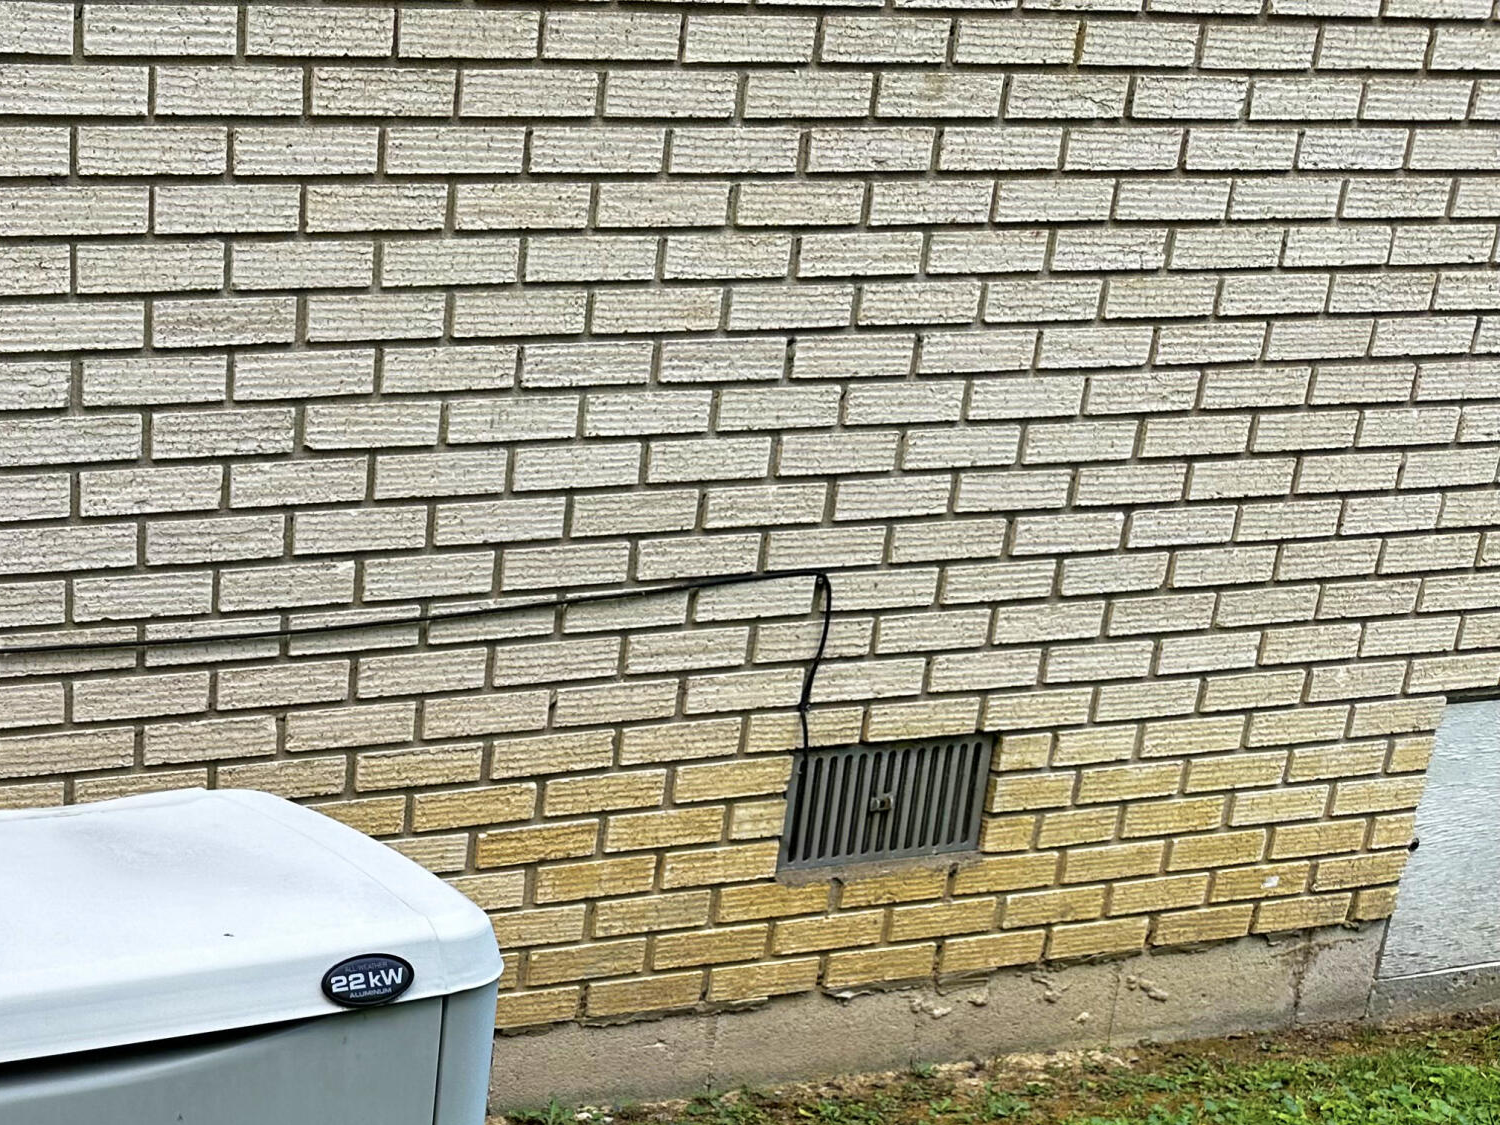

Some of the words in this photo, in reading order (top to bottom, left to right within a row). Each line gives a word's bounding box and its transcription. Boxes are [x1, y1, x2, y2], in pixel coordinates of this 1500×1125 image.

[330, 973, 367, 993] 22
[369, 968, 403, 987] kW
[349, 988, 392, 999] ALUMINUM
